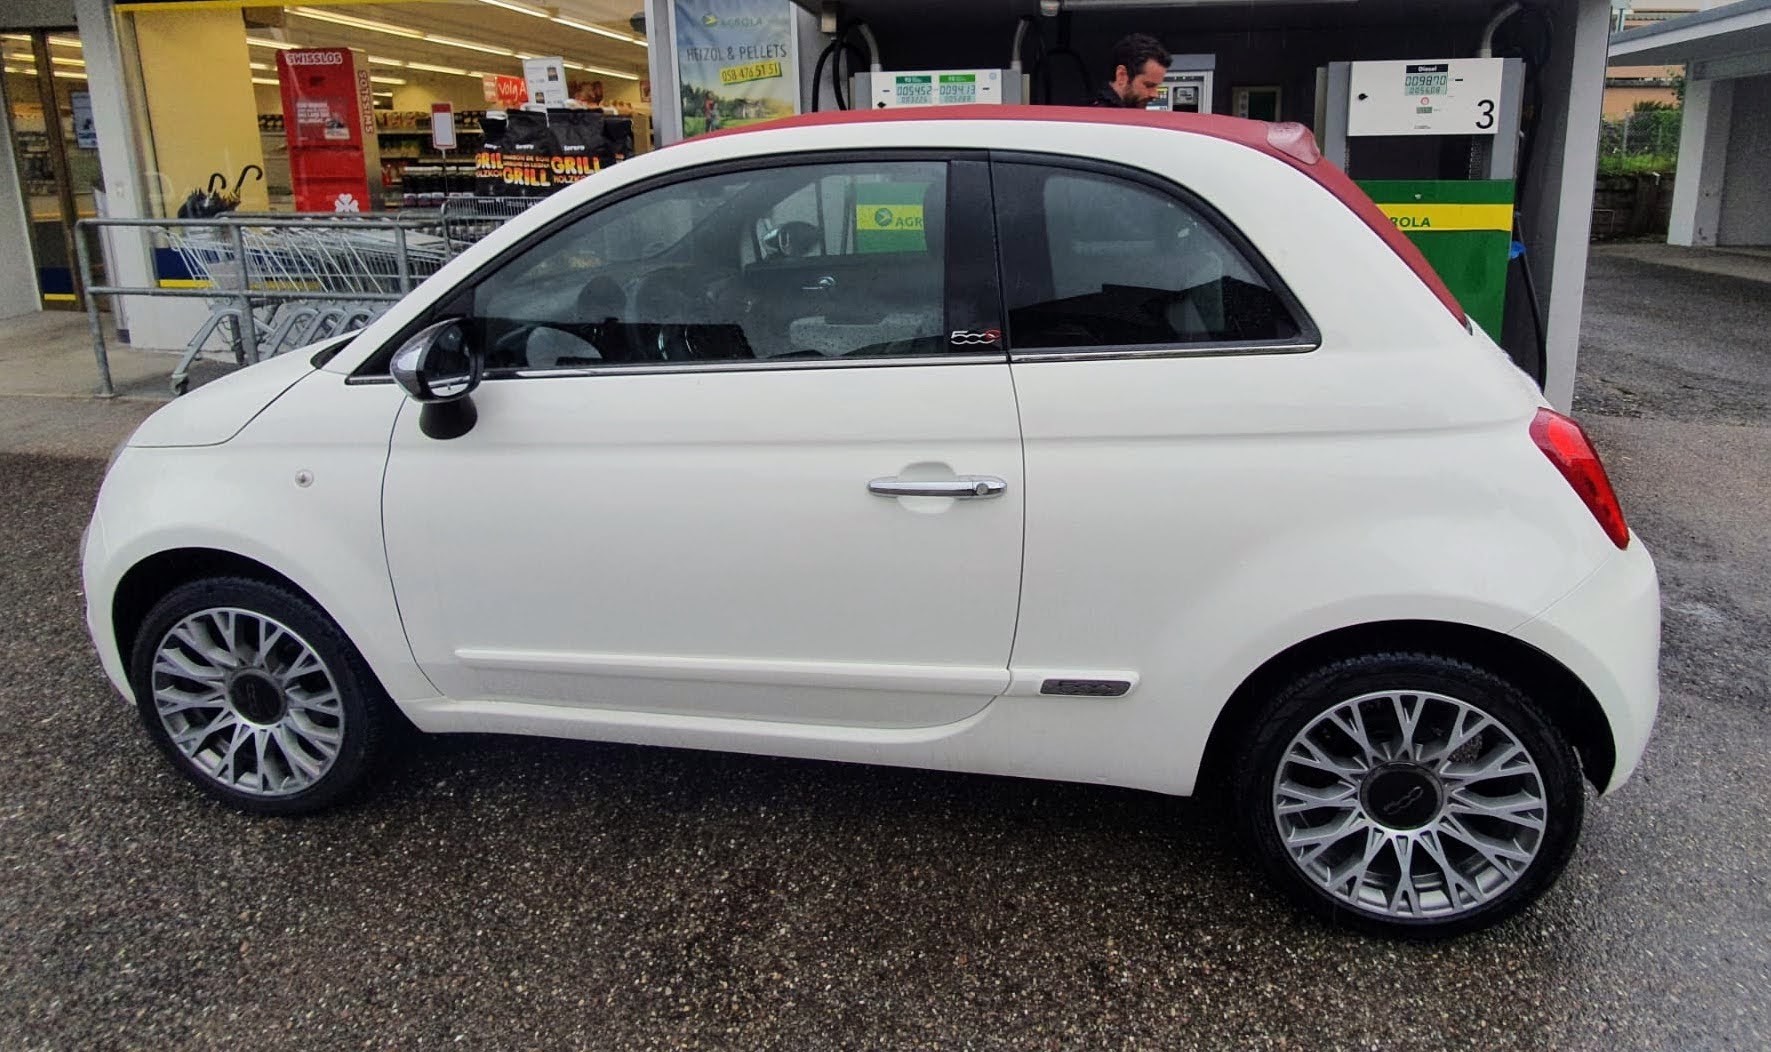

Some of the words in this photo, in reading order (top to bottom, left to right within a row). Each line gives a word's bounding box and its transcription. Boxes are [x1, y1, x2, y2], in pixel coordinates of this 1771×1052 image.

[285, 52, 343, 65] SWISSLOS
[727, 46, 735, 60] &
[739, 44, 787, 60] PELLETS
[1405, 75, 1447, 87] 009870
[498, 80, 519, 102] Volg
[1475, 99, 1495, 129] 3
[551, 156, 601, 175] GRILL
[502, 167, 551, 187] GRILL
[1390, 216, 1431, 228] ROLA
